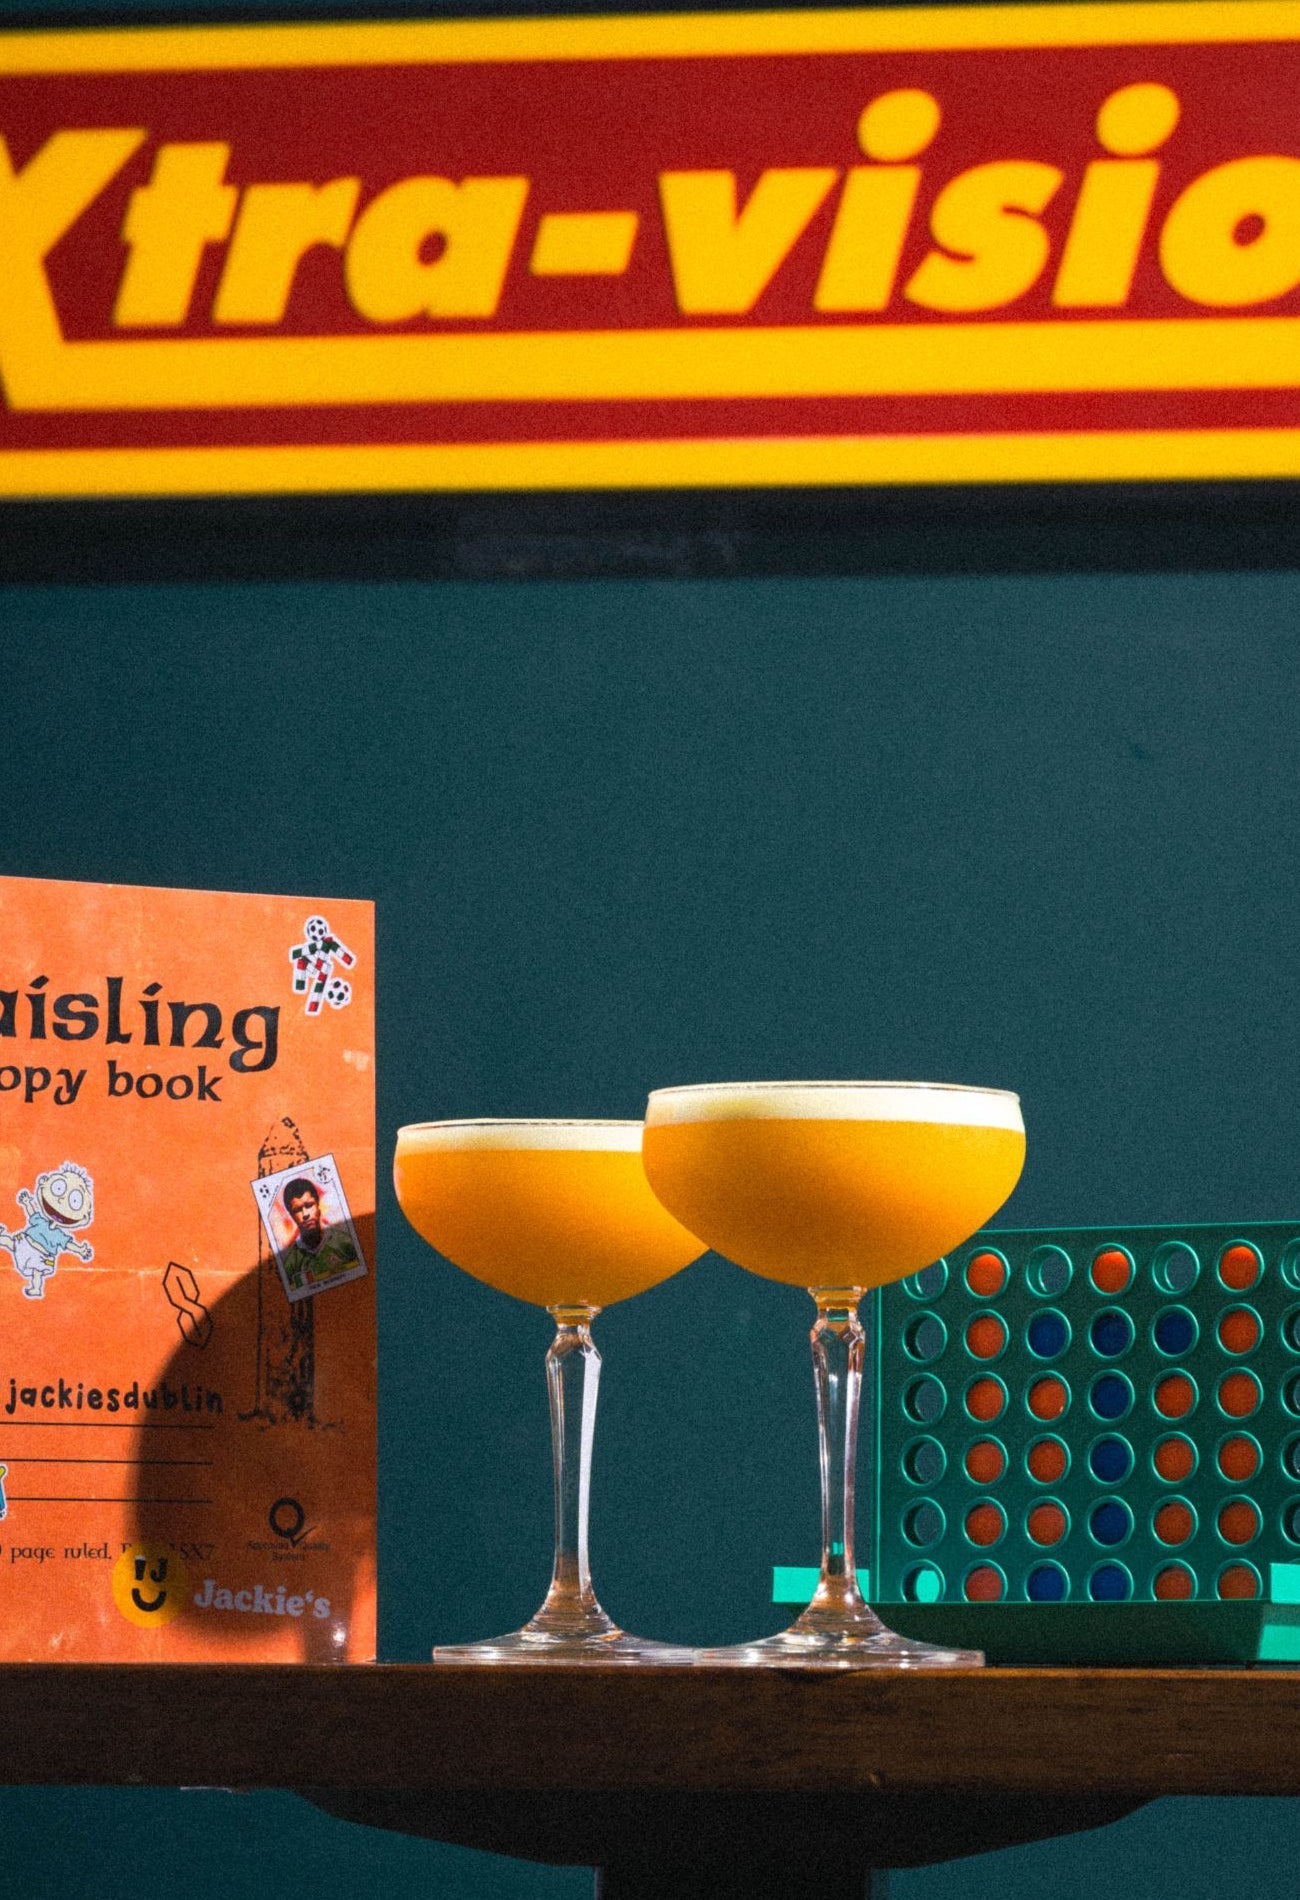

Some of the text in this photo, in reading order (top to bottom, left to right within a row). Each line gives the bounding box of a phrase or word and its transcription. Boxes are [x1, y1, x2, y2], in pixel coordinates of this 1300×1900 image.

[107, 1060, 223, 1101] book
[5, 1377, 223, 1415] jackiesdublin
[11, 1547, 55, 1564] page
[64, 1543, 112, 1560] ruled.
[193, 1578, 332, 1619] Jackie's
